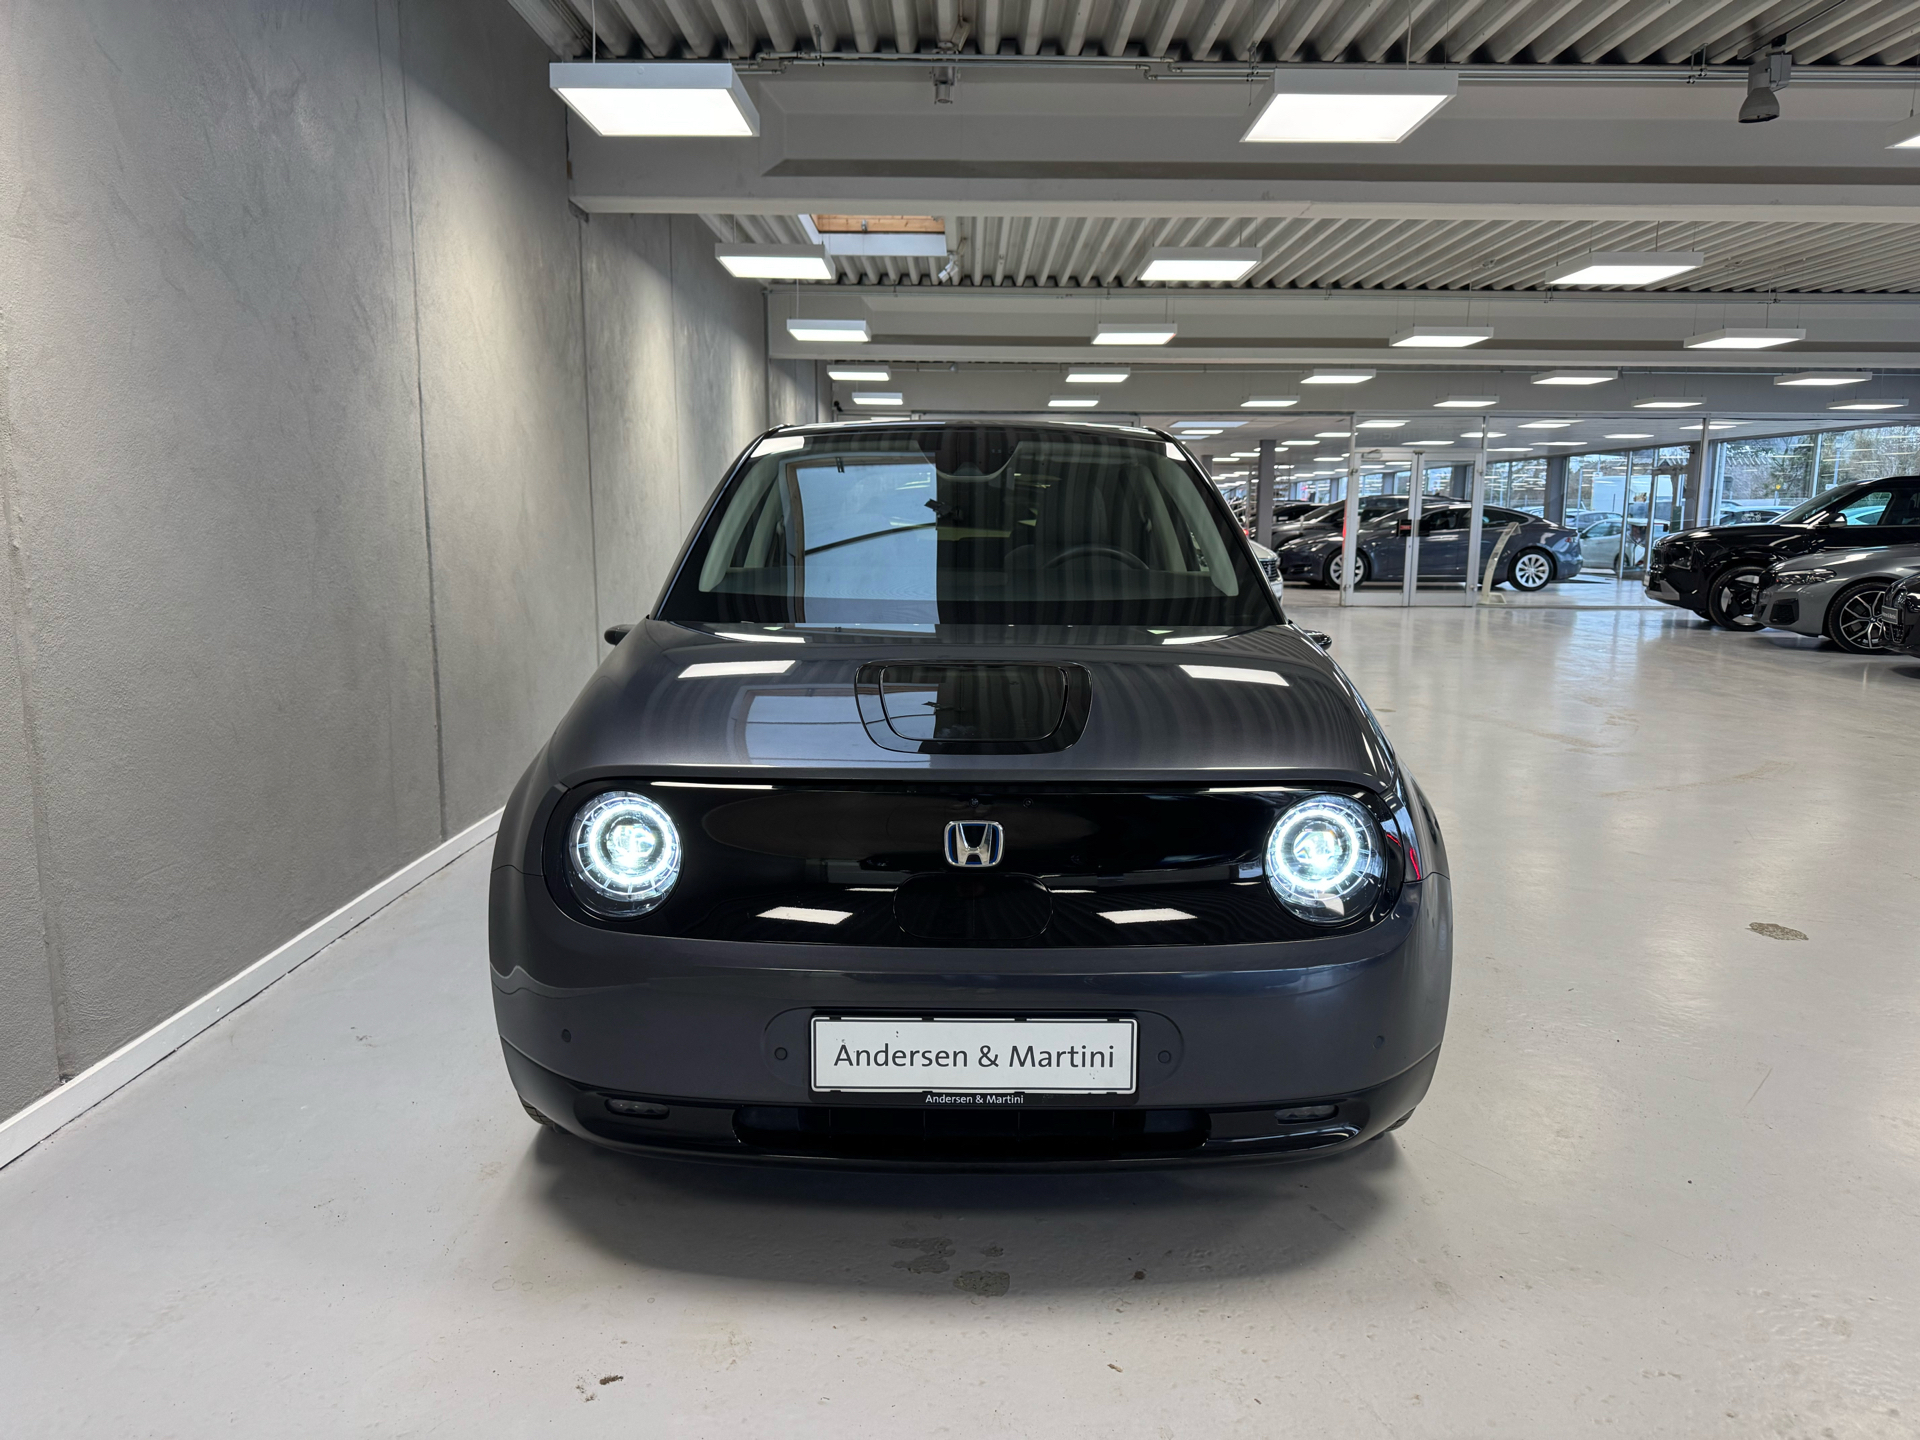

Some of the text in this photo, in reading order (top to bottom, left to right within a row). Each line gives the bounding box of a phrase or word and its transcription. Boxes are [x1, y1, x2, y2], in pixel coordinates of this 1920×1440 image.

[833, 1043, 1114, 1068] Andersen & Martini
[925, 1094, 1024, 1104] Andersen & Martini
